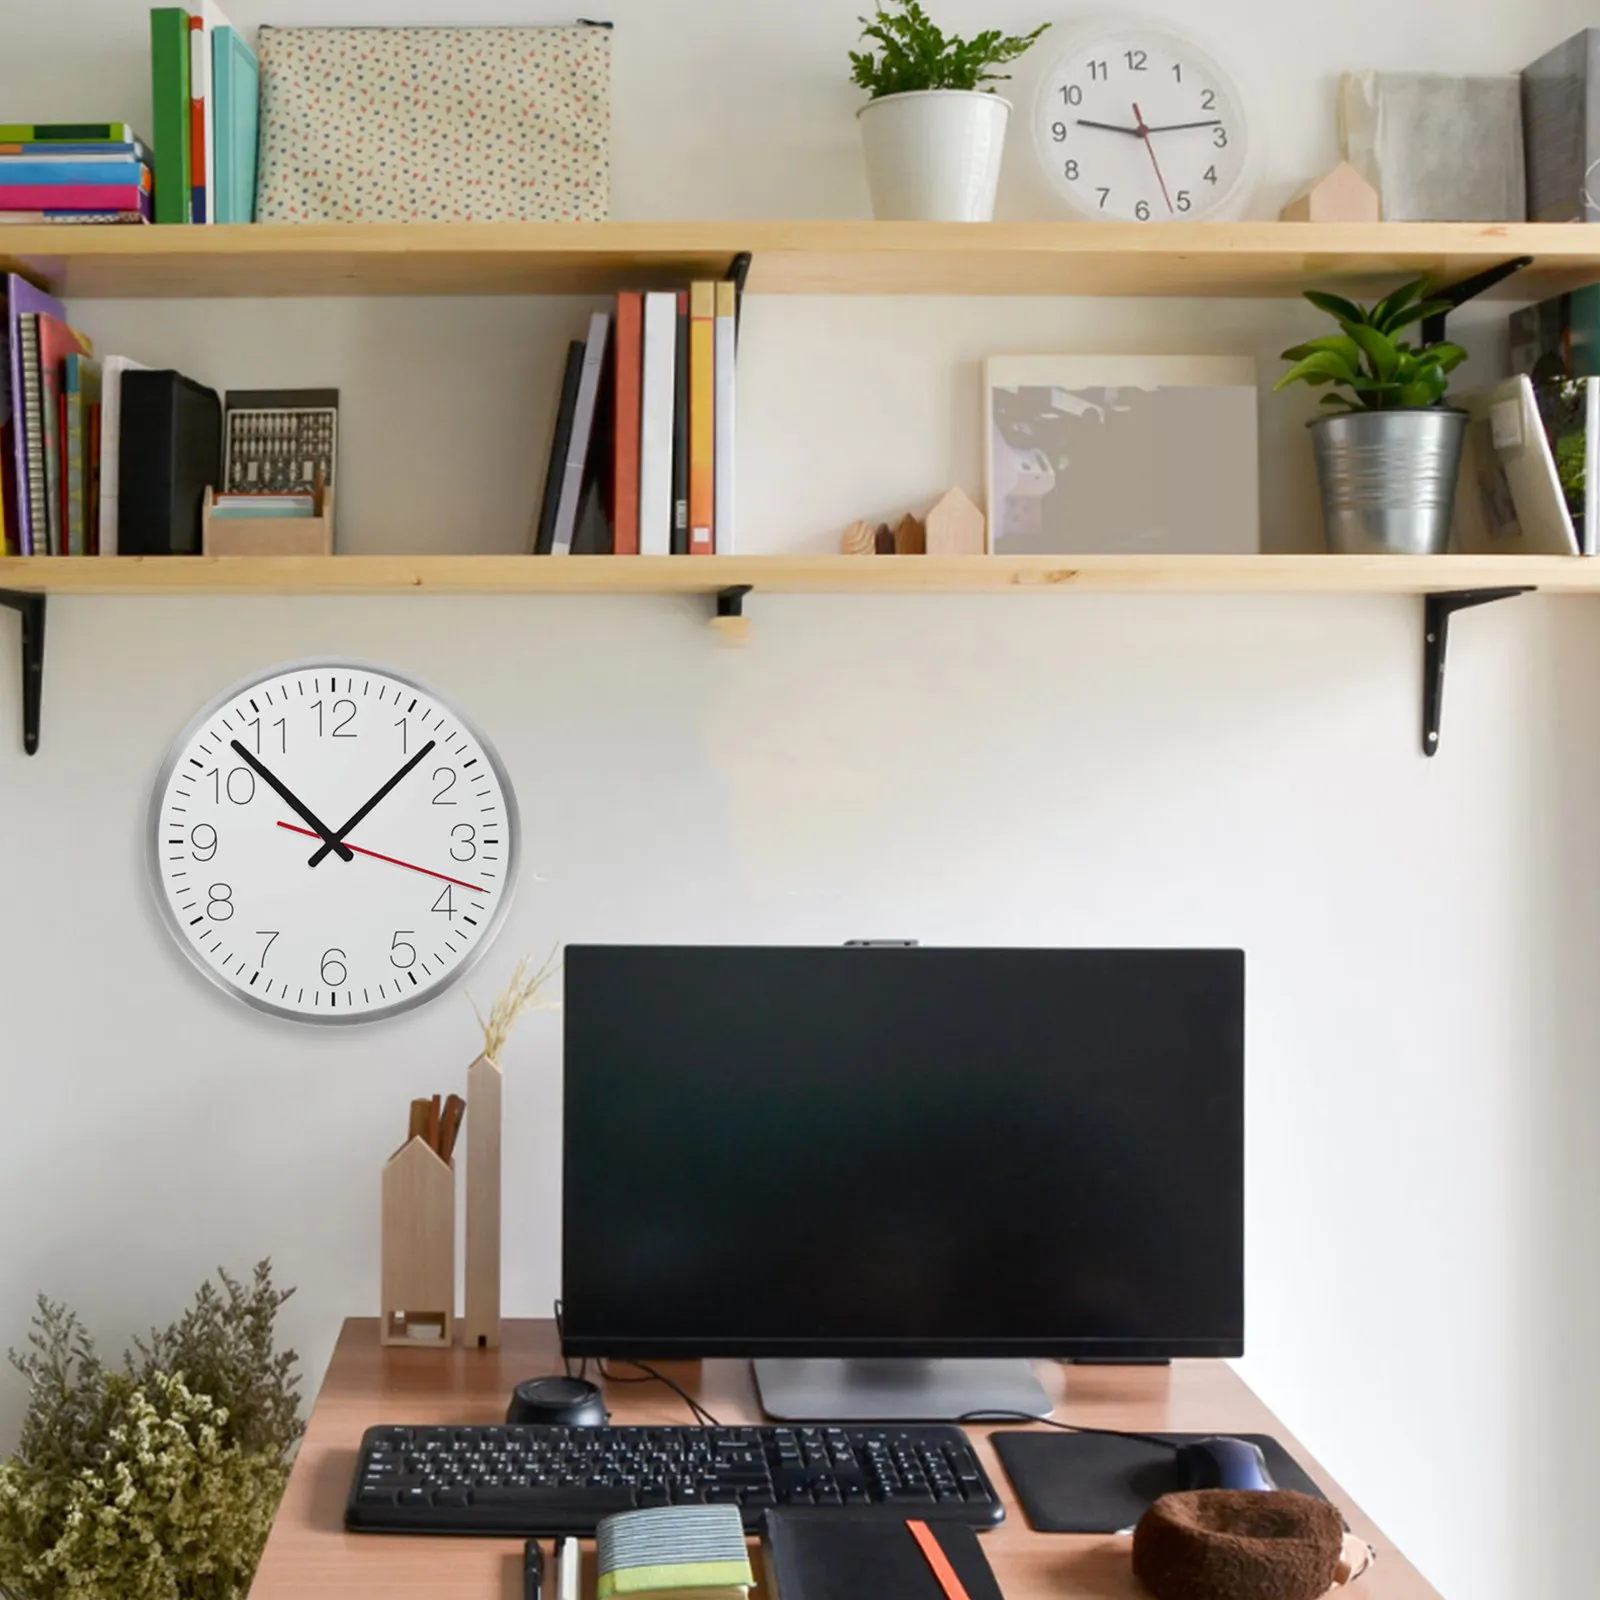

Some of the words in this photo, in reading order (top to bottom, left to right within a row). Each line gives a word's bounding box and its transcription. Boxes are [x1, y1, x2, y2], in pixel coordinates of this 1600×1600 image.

[1087, 60, 1108, 80] 11
[1124, 51, 1148, 71] 12
[1172, 64, 1181, 83] 1
[1059, 85, 1082, 106] 10
[1201, 89, 1216, 110] 2
[1052, 122, 1067, 142] 9
[1213, 127, 1228, 148] 3
[1065, 159, 1080, 181] 8
[1203, 165, 1218, 185] 4
[1096, 187, 1111, 208] 7
[1135, 200, 1150, 221] 6
[1177, 191, 1191, 212] 5
[310, 699, 358, 737] 12
[247, 717, 285, 754] 11
[394, 717, 406, 754] 1
[206, 767, 256, 805] 10
[431, 767, 458, 805] 2
[190, 823, 218, 862] 9
[449, 823, 477, 862] 3
[206, 882, 234, 921] 8
[431, 884, 458, 921] 4
[255, 931, 280, 968] 7
[389, 930, 416, 968] 5
[320, 948, 347, 986] 6
